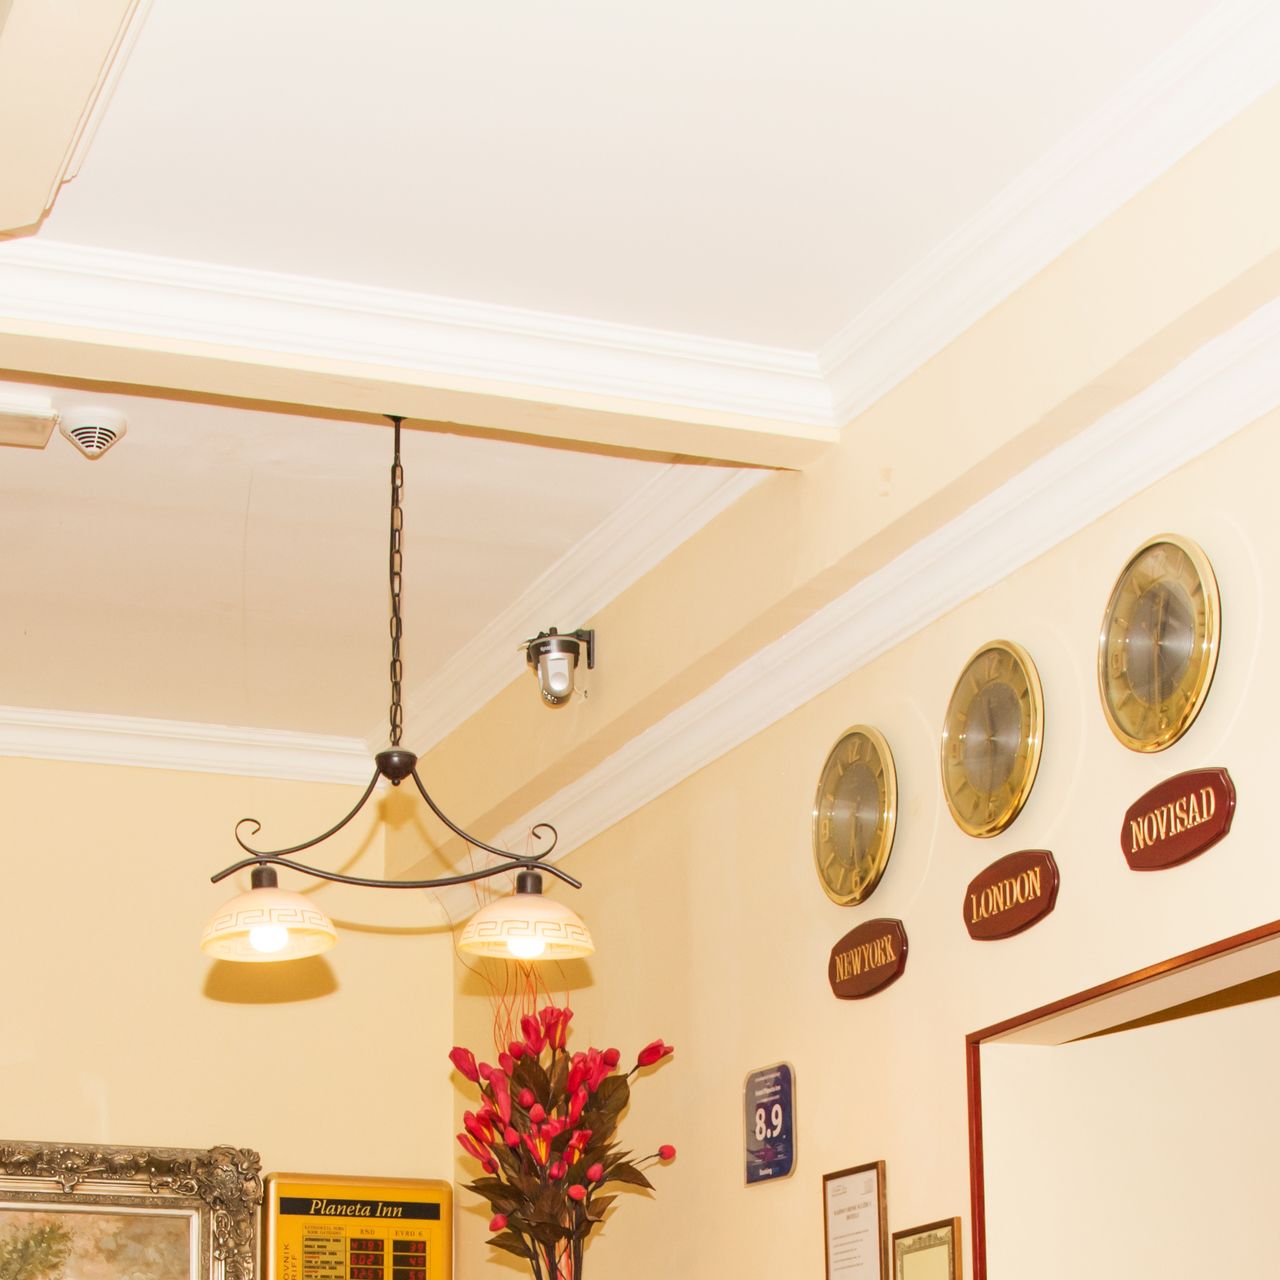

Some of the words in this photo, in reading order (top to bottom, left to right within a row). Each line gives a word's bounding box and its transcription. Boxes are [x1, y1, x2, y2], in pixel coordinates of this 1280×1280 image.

[1129, 786, 1217, 853] NOVISAD
[969, 865, 1042, 925] LONDON
[834, 933, 898, 984] NEWYORK
[755, 1103, 783, 1141] 8.9
[309, 1199, 371, 1217] Planeta
[375, 1202, 403, 1218] Inn
